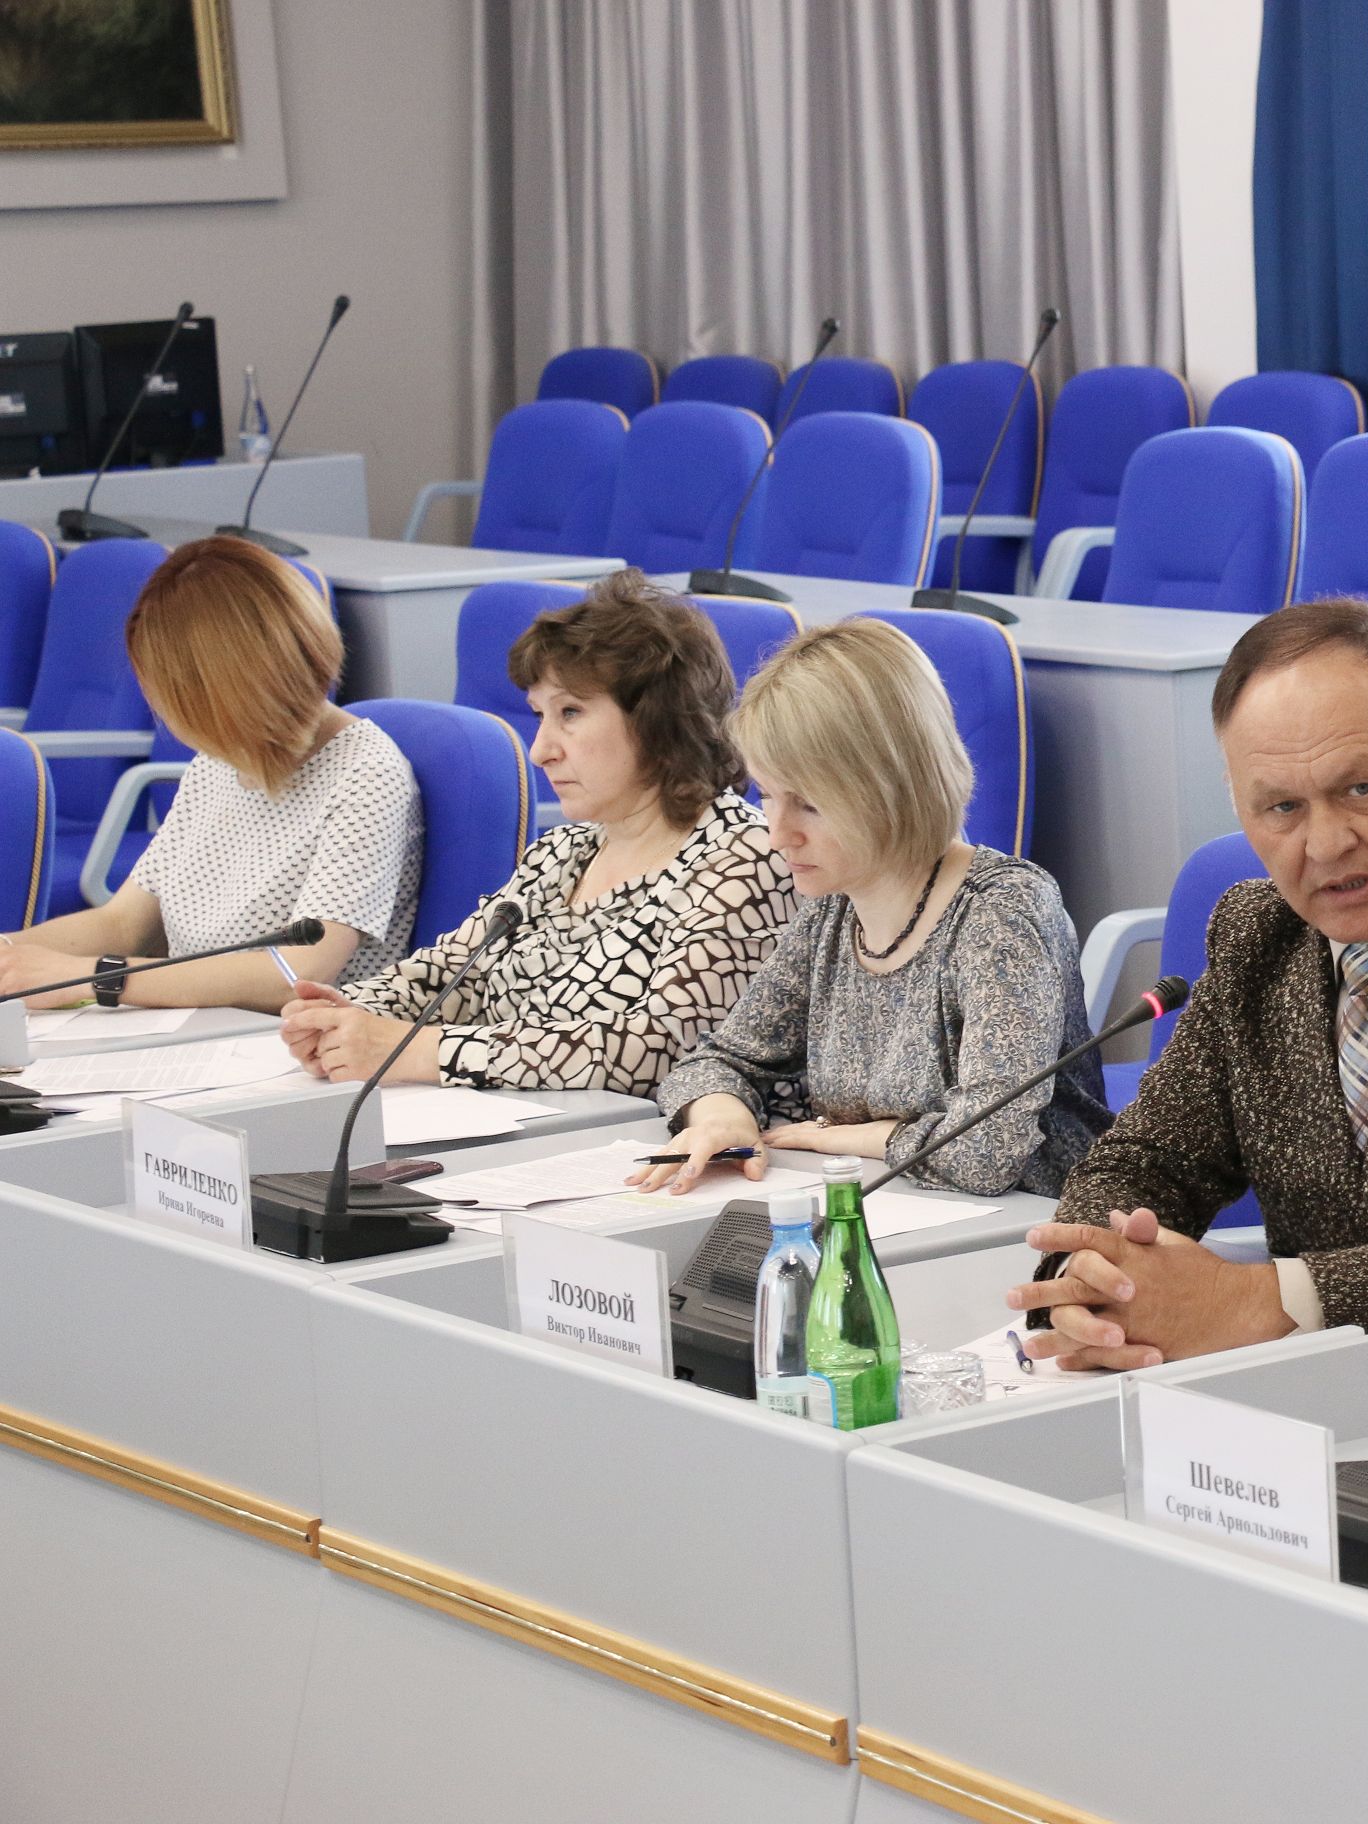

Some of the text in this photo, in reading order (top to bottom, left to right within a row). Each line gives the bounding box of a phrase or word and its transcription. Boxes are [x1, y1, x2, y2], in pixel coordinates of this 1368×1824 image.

[144, 1152, 238, 1205] ГАВРИЛЕНКО
[158, 1190, 225, 1228] Ирина Игоревна
[548, 1279, 635, 1323] ЛОЗОВОЙ
[547, 1315, 641, 1355] Виктор Иванович
[1190, 1460, 1281, 1510] Шевелев
[1166, 1494, 1309, 1550] Сергей Арнольдович
